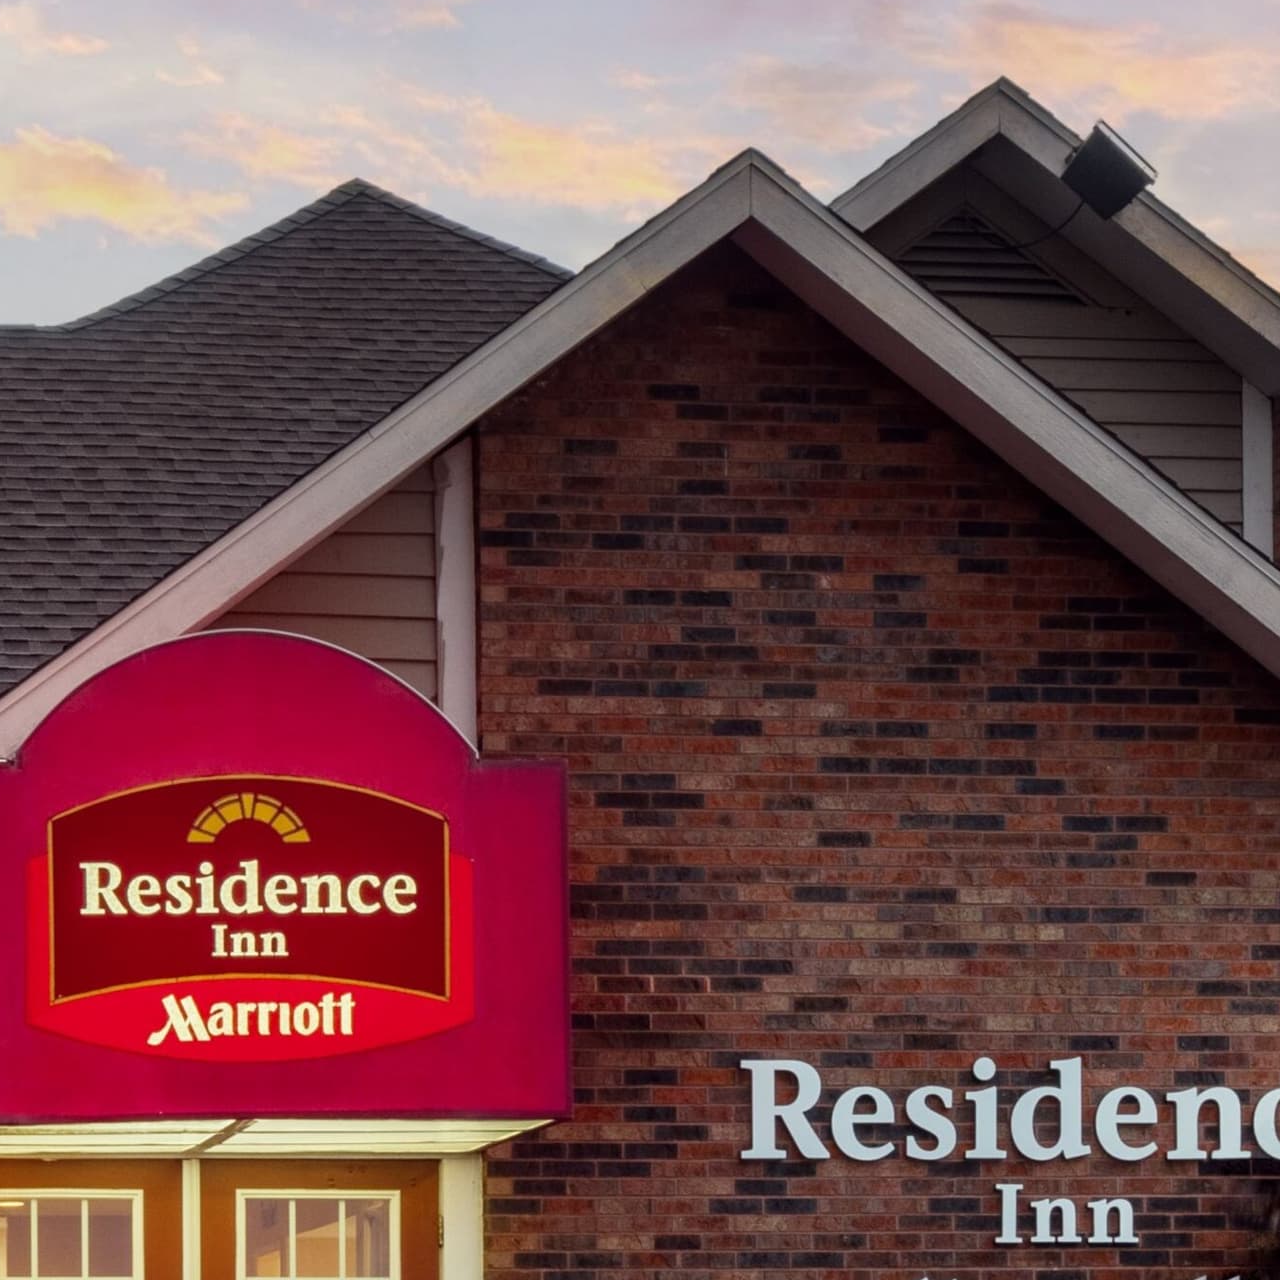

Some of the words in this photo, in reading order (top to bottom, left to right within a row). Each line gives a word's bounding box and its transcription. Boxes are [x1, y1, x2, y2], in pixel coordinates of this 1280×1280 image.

[79, 859, 417, 916] Residence
[211, 924, 289, 957] Inn
[147, 992, 356, 1046] Marriott
[994, 1183, 1140, 1244] Inn
